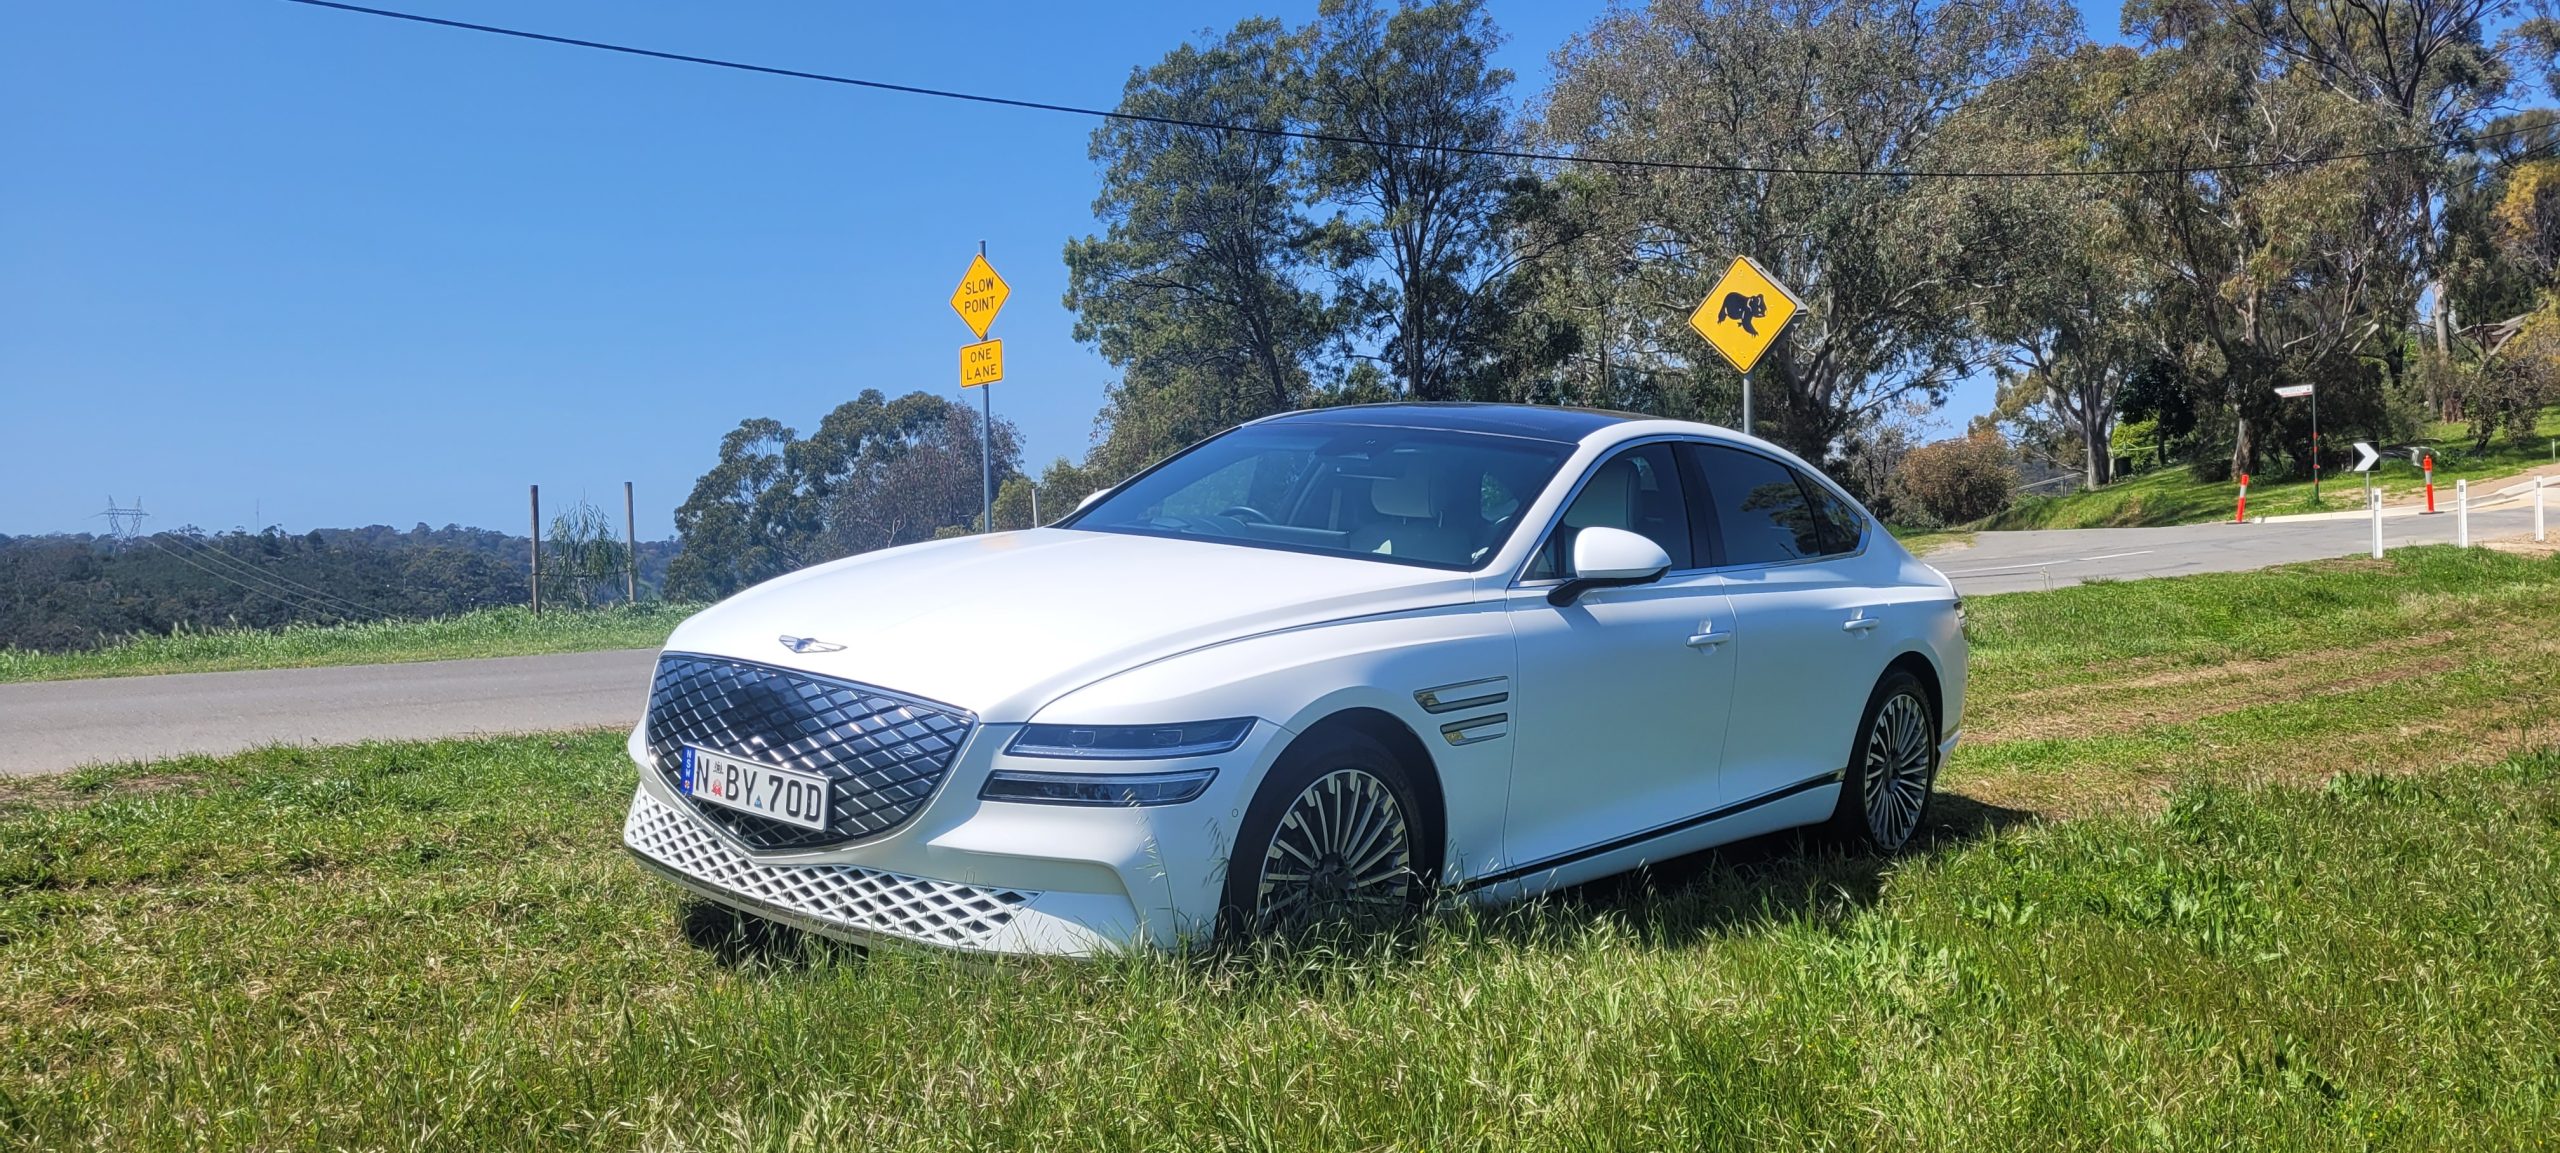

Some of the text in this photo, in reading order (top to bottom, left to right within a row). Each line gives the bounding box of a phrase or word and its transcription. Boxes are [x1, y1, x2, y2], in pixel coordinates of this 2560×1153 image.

[965, 277, 994, 295] SLOW
[965, 296, 995, 314] POINT
[970, 347, 992, 363] ONE
[966, 363, 997, 380] LANE
[768, 774, 822, 823] 70D
